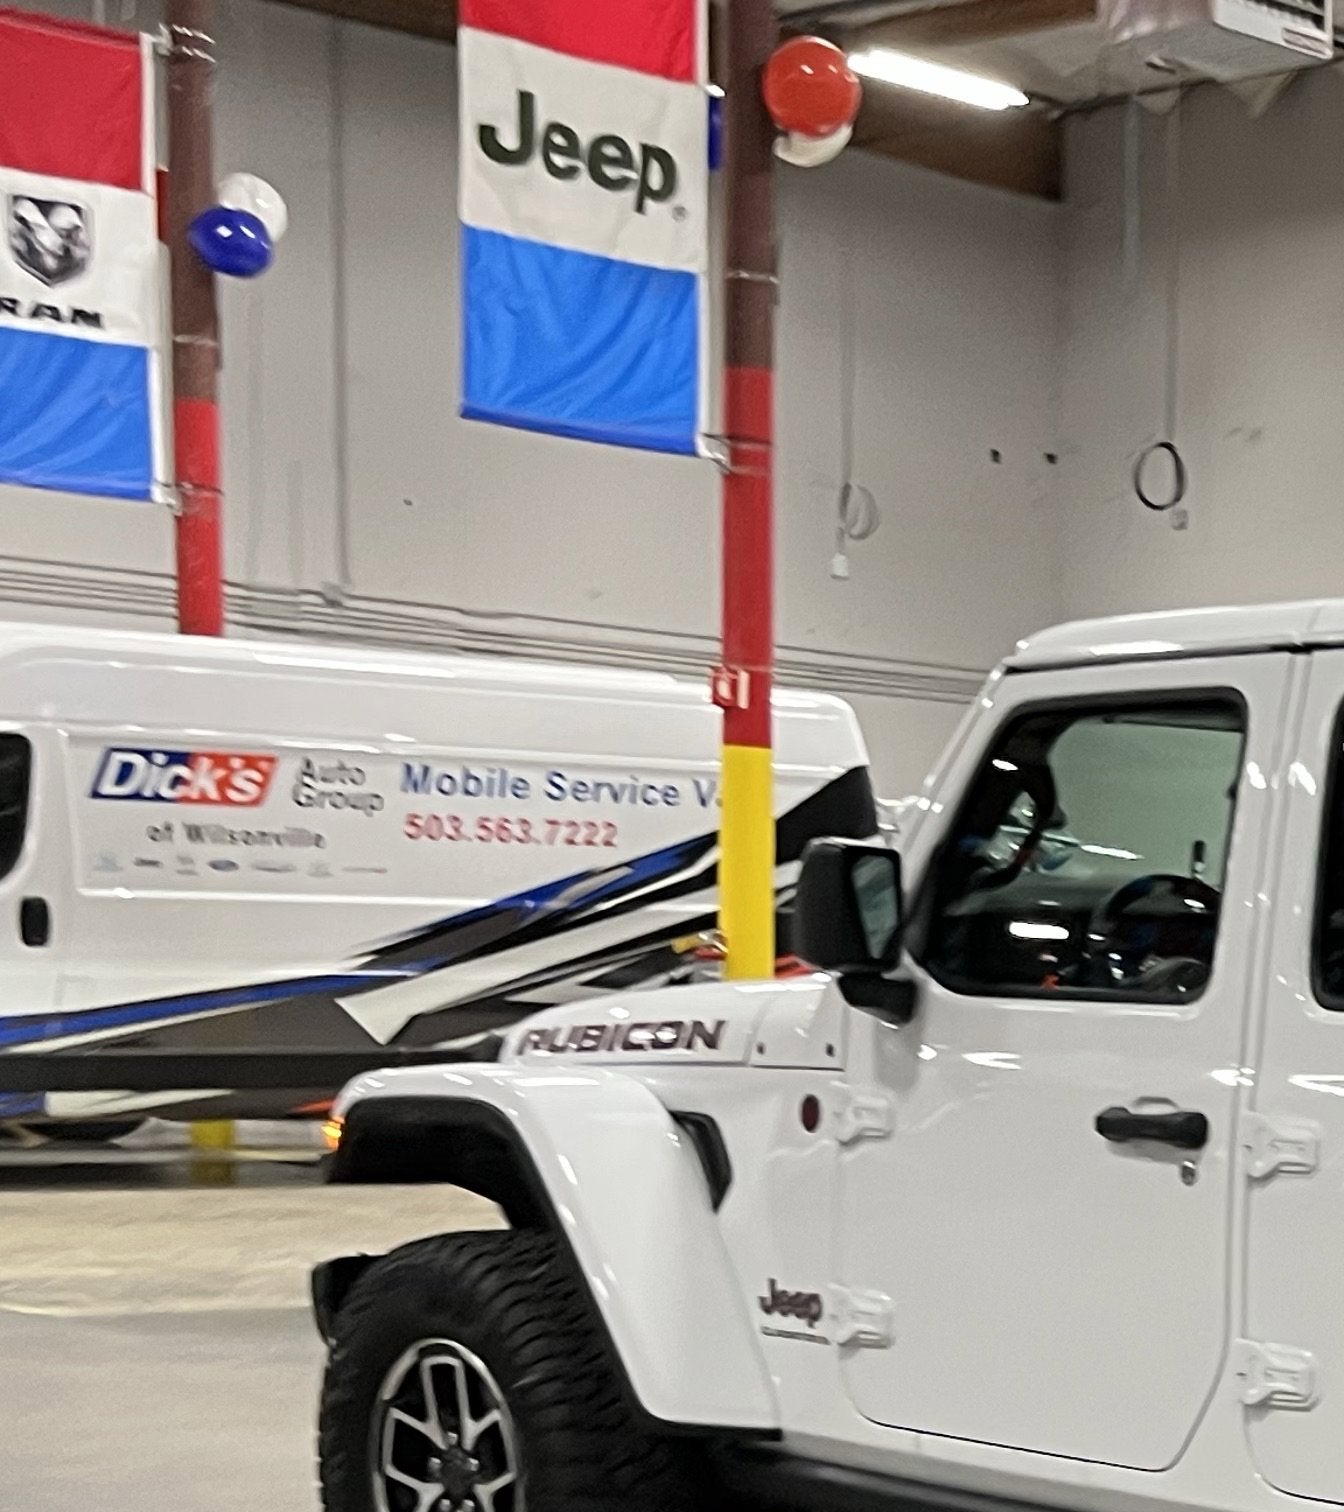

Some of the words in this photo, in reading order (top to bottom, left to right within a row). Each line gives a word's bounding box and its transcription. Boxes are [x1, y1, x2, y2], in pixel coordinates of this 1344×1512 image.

[479, 89, 677, 216] Jeep
[96, 750, 267, 806] Dick's
[299, 756, 366, 786] Auto
[400, 761, 532, 800] Mobile
[543, 769, 681, 807] Service
[293, 780, 385, 817] Group
[402, 811, 619, 848] 503.563.7222
[515, 1018, 728, 1056] RUBICON
[757, 1277, 823, 1330] Jeep
